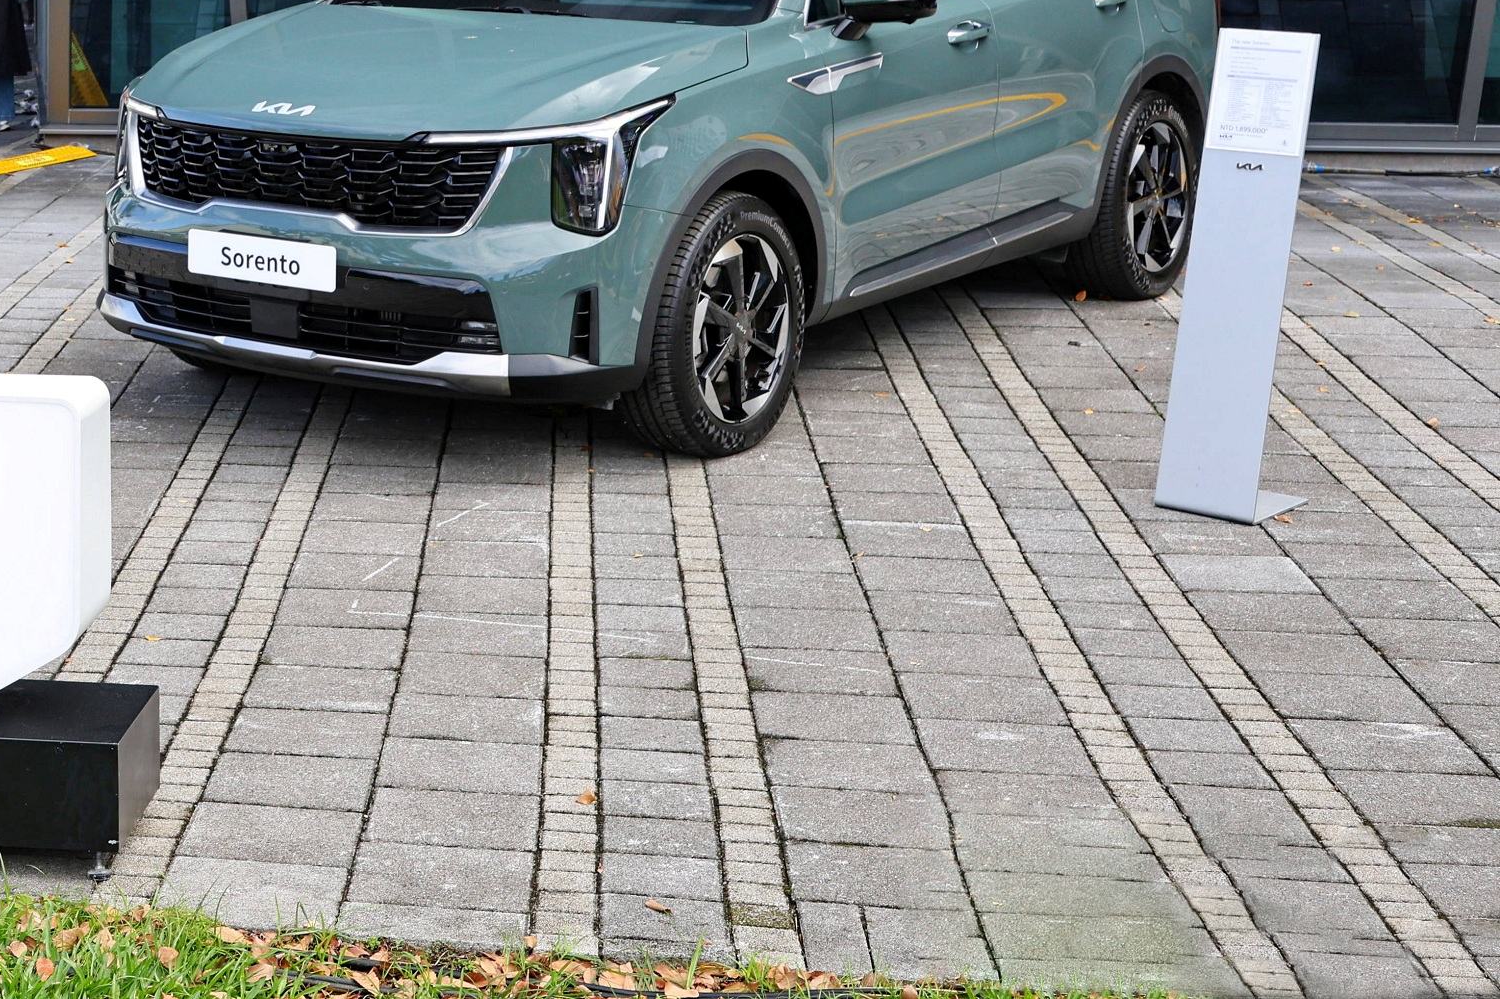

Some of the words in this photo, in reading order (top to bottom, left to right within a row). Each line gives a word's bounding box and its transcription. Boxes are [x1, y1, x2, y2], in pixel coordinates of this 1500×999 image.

[251, 100, 316, 117] KIA
[1236, 162, 1263, 171] KIA
[221, 246, 300, 276] Sorento
